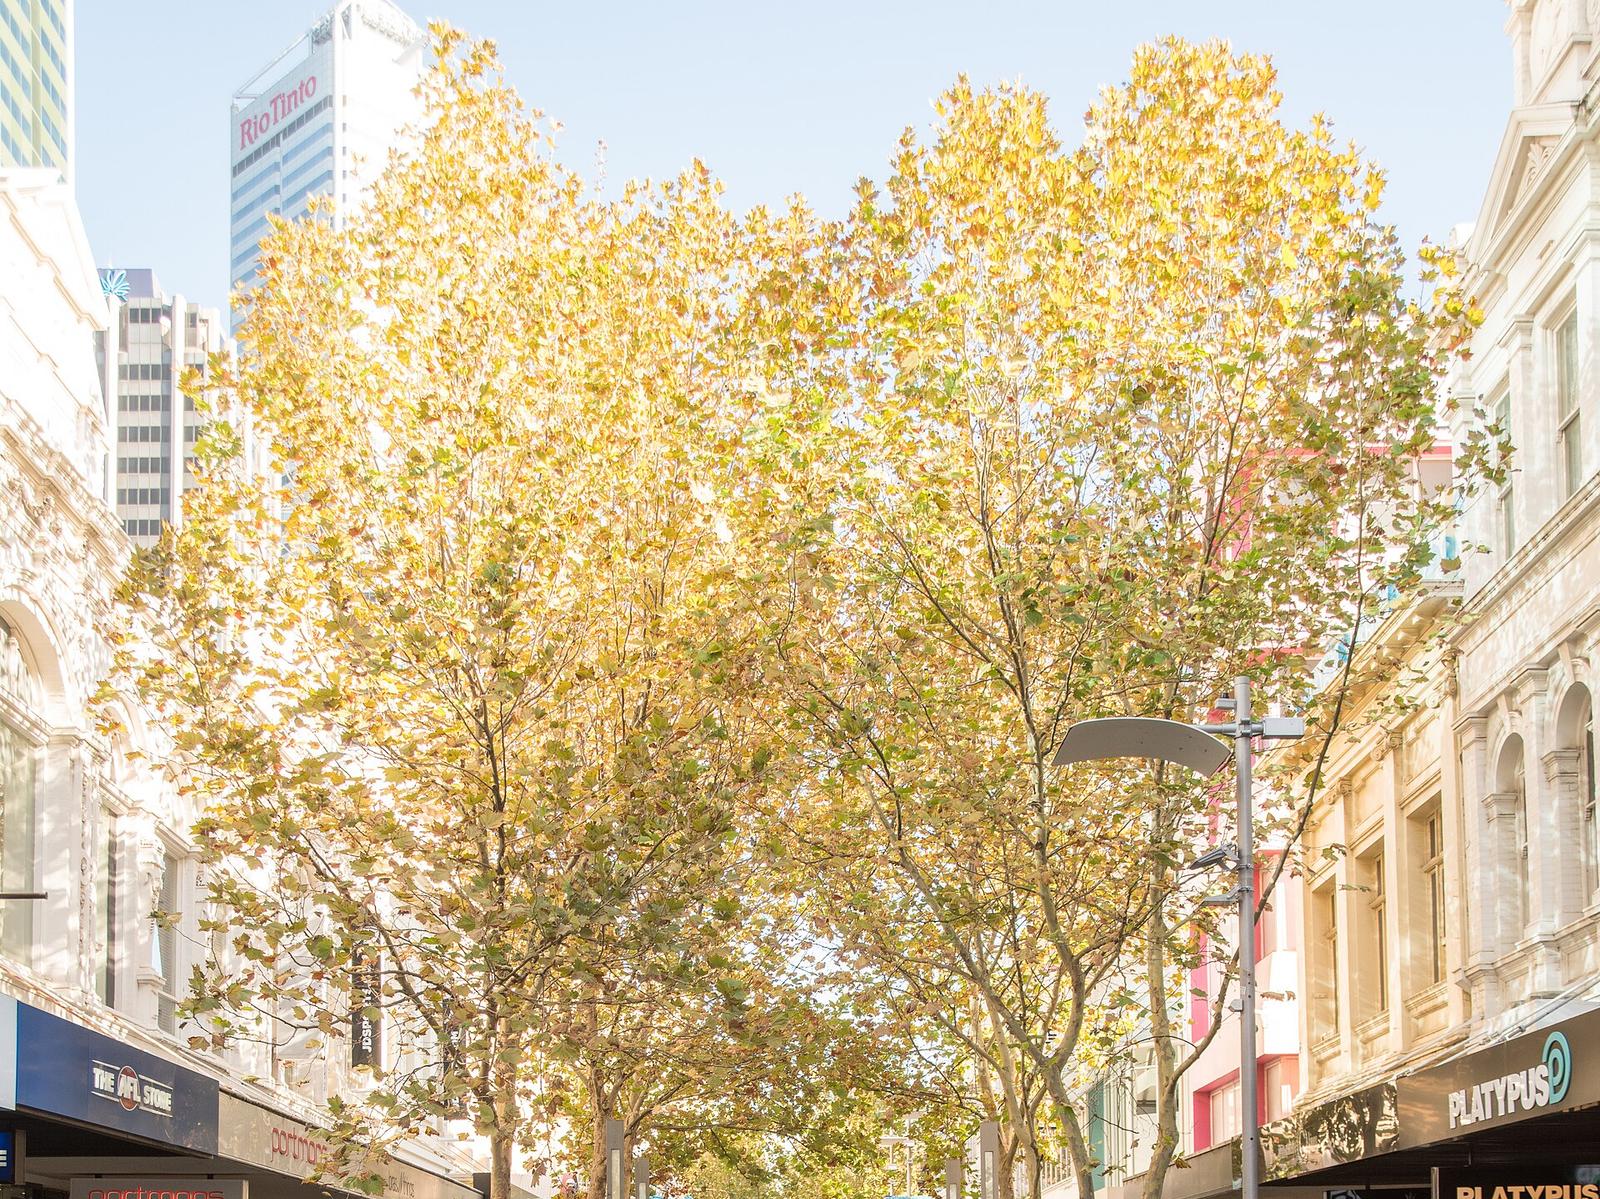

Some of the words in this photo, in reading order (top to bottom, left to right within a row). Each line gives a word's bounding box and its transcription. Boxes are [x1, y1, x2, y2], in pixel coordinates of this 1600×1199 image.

[240, 112, 270, 151] Rio
[269, 75, 317, 125] Tinto
[93, 1067, 115, 1093] THE
[118, 1073, 141, 1102] AFL
[143, 1085, 172, 1111] STORE
[1448, 1064, 1550, 1129] PLATYPUS
